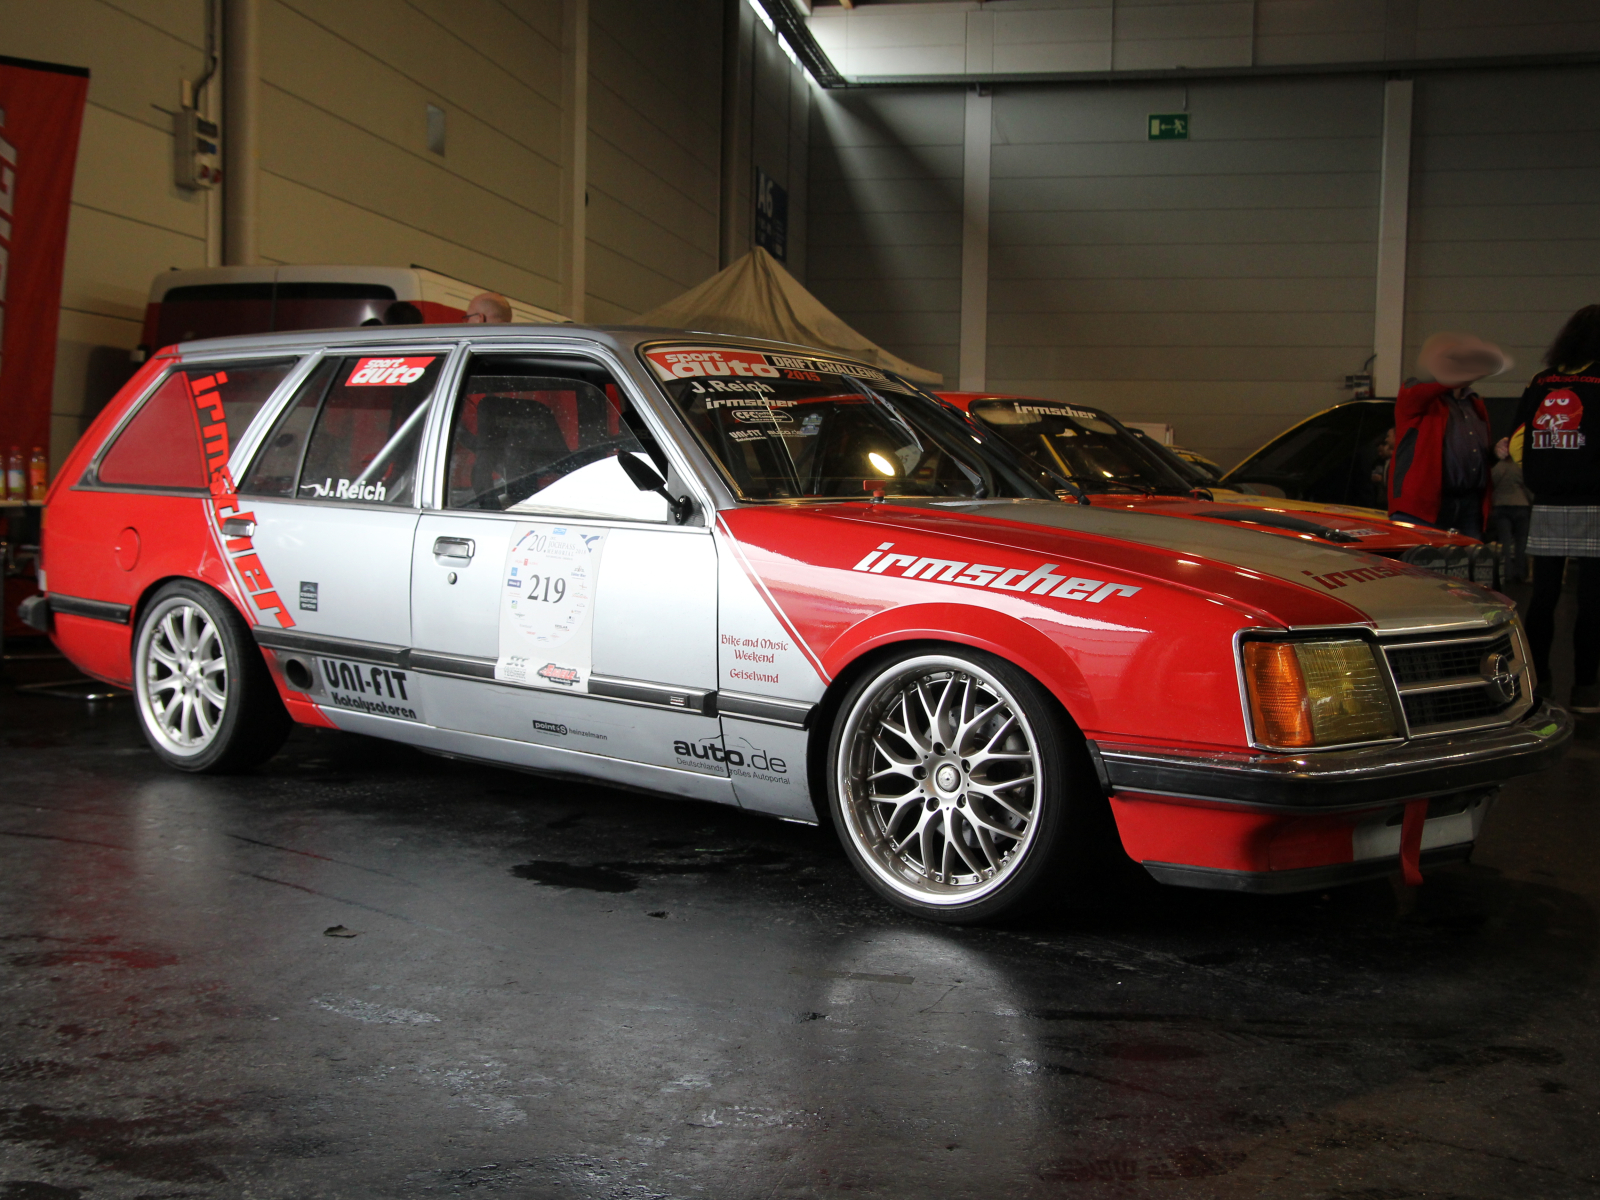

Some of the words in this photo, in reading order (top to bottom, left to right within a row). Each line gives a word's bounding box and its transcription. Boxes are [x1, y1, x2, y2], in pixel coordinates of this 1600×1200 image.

[758, 172, 773, 218] A6
[364, 358, 405, 369] sport
[665, 352, 723, 363] sport
[772, 356, 816, 370] DRIFT
[351, 365, 425, 384] auto
[671, 360, 780, 378] auto
[784, 369, 821, 382] 2015
[705, 398, 798, 409] irmscher
[1013, 402, 1097, 419] irmscher
[190, 371, 296, 628] irmscher
[852, 541, 1143, 603] irmscher
[527, 574, 566, 604] 219
[721, 634, 741, 647] Bike
[742, 638, 759, 648] and
[760, 639, 789, 651] Music
[734, 650, 774, 663] Weekend
[322, 659, 408, 701] UNI-FIT
[730, 669, 779, 684] Geiselwind
[331, 692, 417, 719] Katalysatoren
[535, 722, 556, 731] point
[568, 728, 608, 740] heinzelmann
[673, 739, 787, 774] auto.de
[676, 757, 724, 773] Deutschlands
[753, 771, 790, 785] Autoportal
